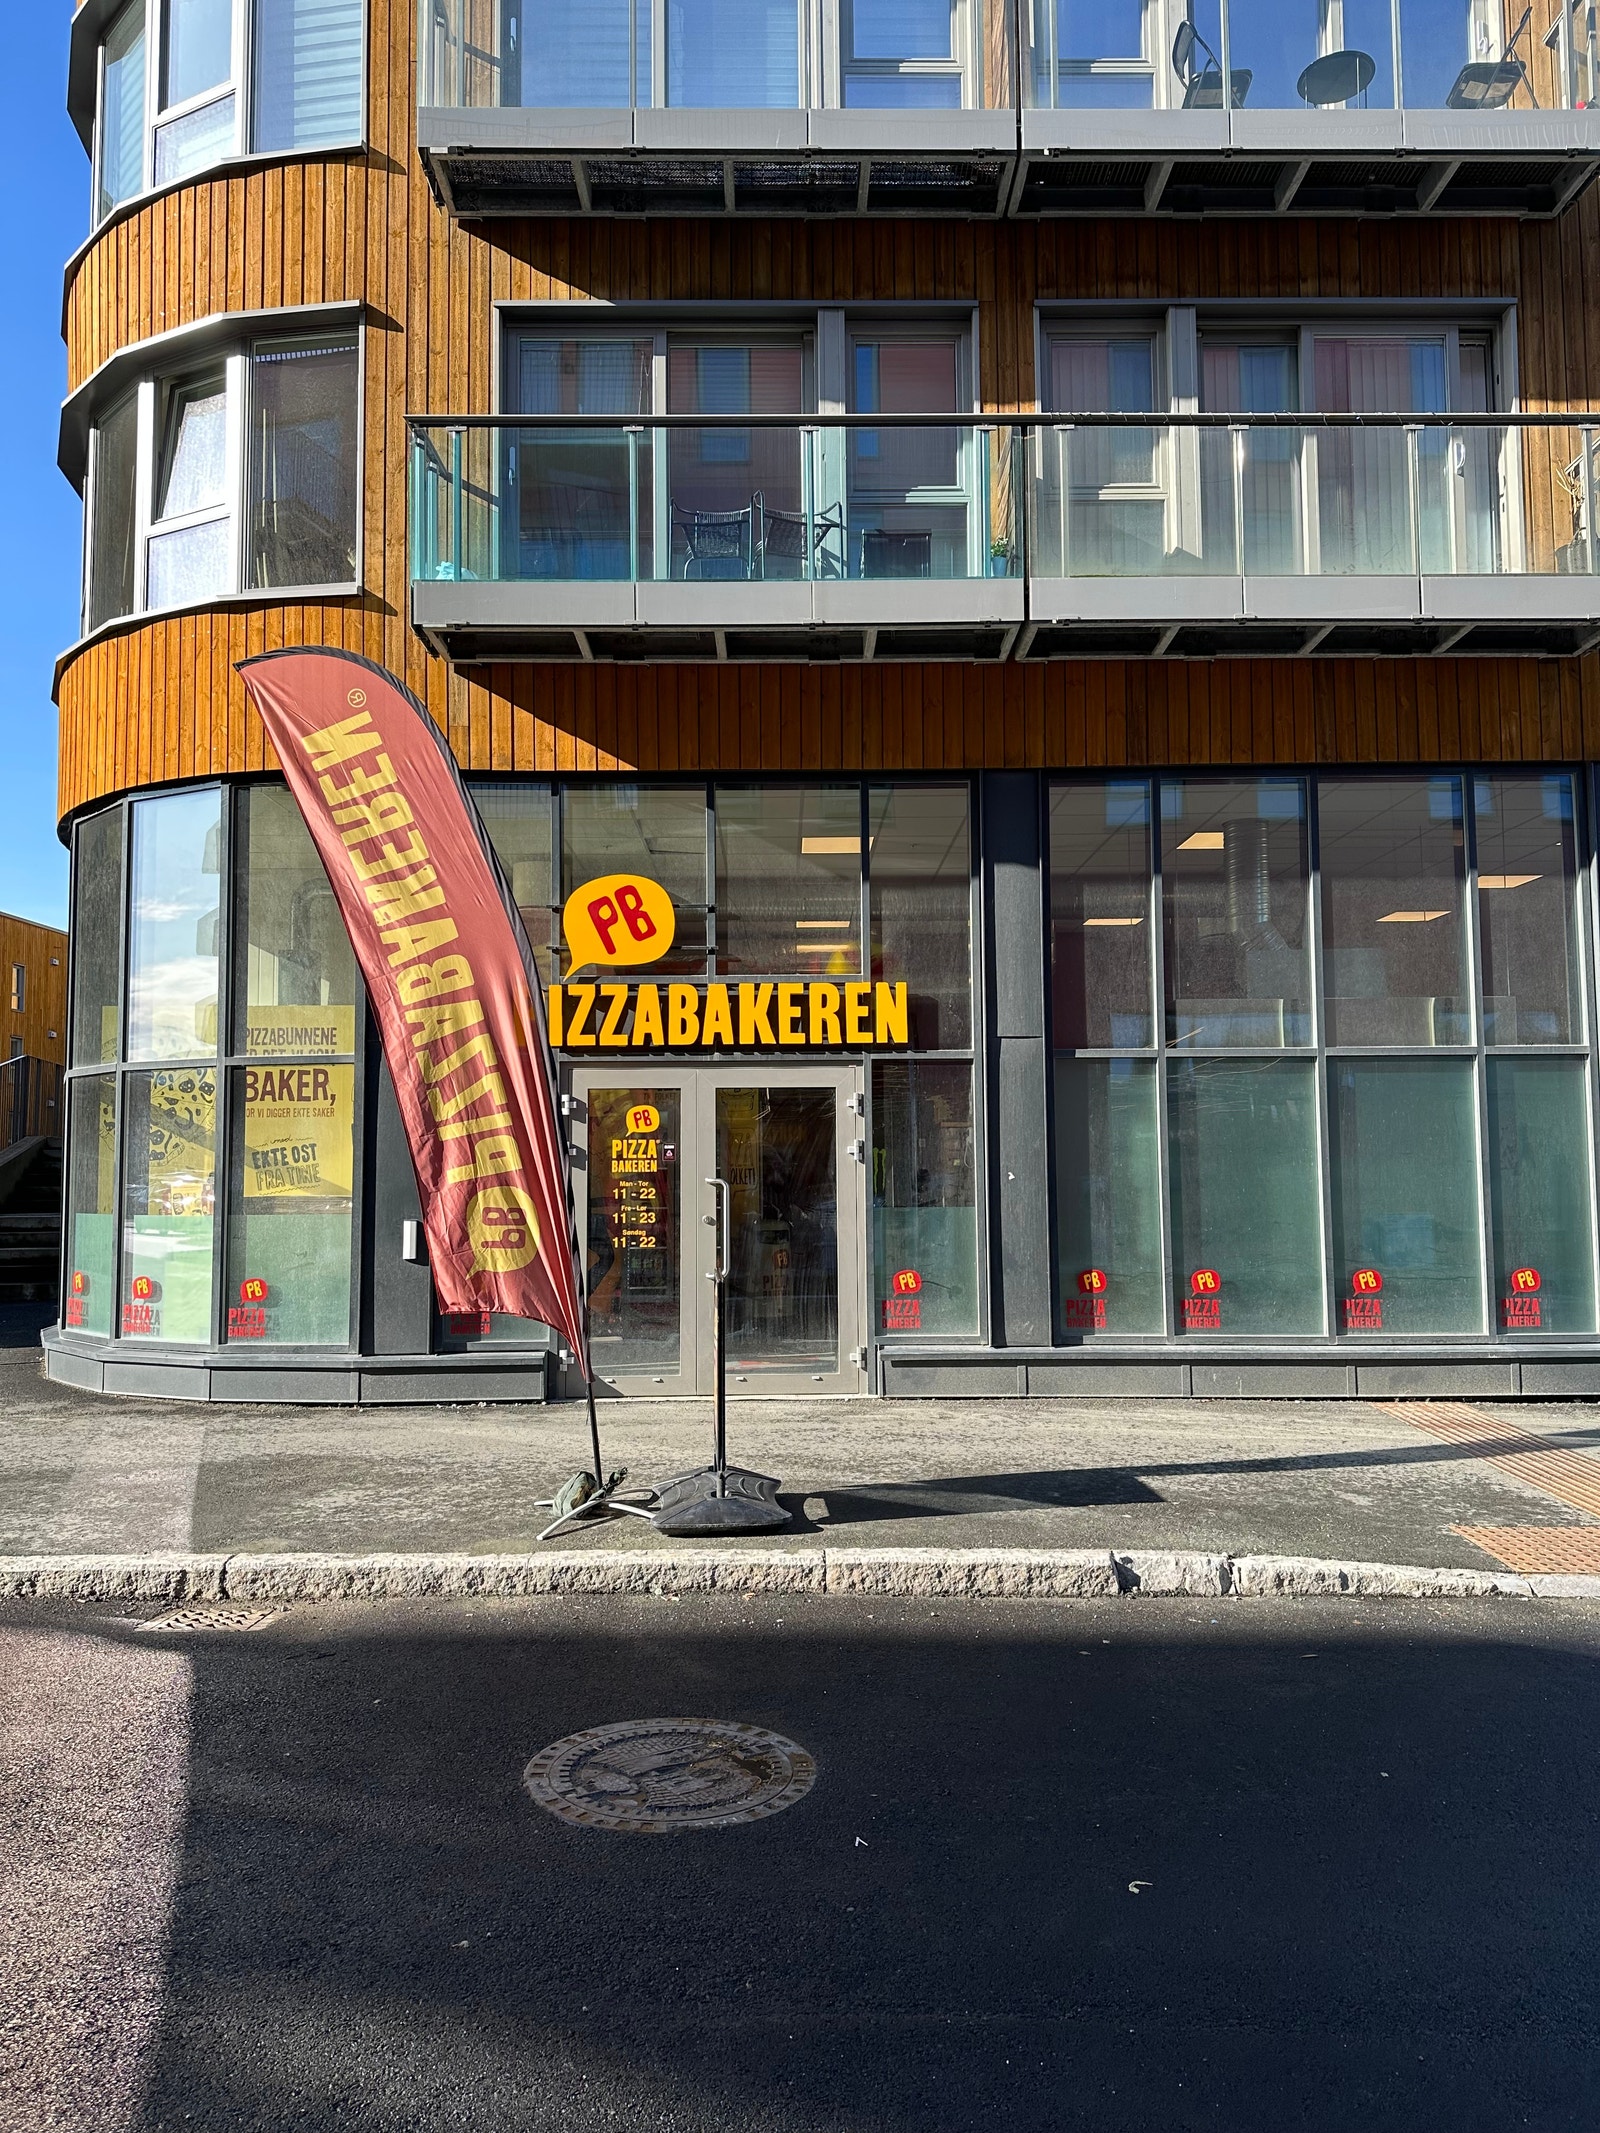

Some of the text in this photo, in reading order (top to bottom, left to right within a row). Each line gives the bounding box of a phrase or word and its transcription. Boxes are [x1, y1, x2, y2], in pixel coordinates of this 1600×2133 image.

[587, 885, 657, 955] PB
[548, 981, 908, 1047] IZZABAKEREN
[312, 1107, 335, 1118] SAKER
[633, 1109, 652, 1129] PB
[252, 1143, 317, 1170] EKTE OST
[612, 1139, 657, 1159] PIZZA
[611, 1160, 657, 1172] BAKEREN
[256, 1168, 286, 1191] FRA
[612, 1188, 626, 1199] 11
[639, 1188, 656, 1199] 22
[612, 1212, 626, 1224] 11
[639, 1212, 656, 1224] 23
[612, 1236, 626, 1248] 11
[639, 1236, 656, 1248] 22
[622, 1229, 646, 1237] Søndag
[136, 1278, 149, 1295] PB
[899, 1272, 916, 1290] PB
[1083, 1272, 1101, 1290] PB
[1197, 1272, 1215, 1290] PB
[1359, 1271, 1377, 1289] PB
[1517, 1271, 1535, 1289] PB
[246, 1280, 262, 1299] PB
[882, 1299, 919, 1316] PIZZA
[1066, 1299, 1105, 1316] PIZZA
[1181, 1298, 1219, 1316] PIZZA
[1343, 1298, 1381, 1316] PIZZA
[1502, 1298, 1540, 1315] PIZZA
[228, 1307, 265, 1325] PIZZA
